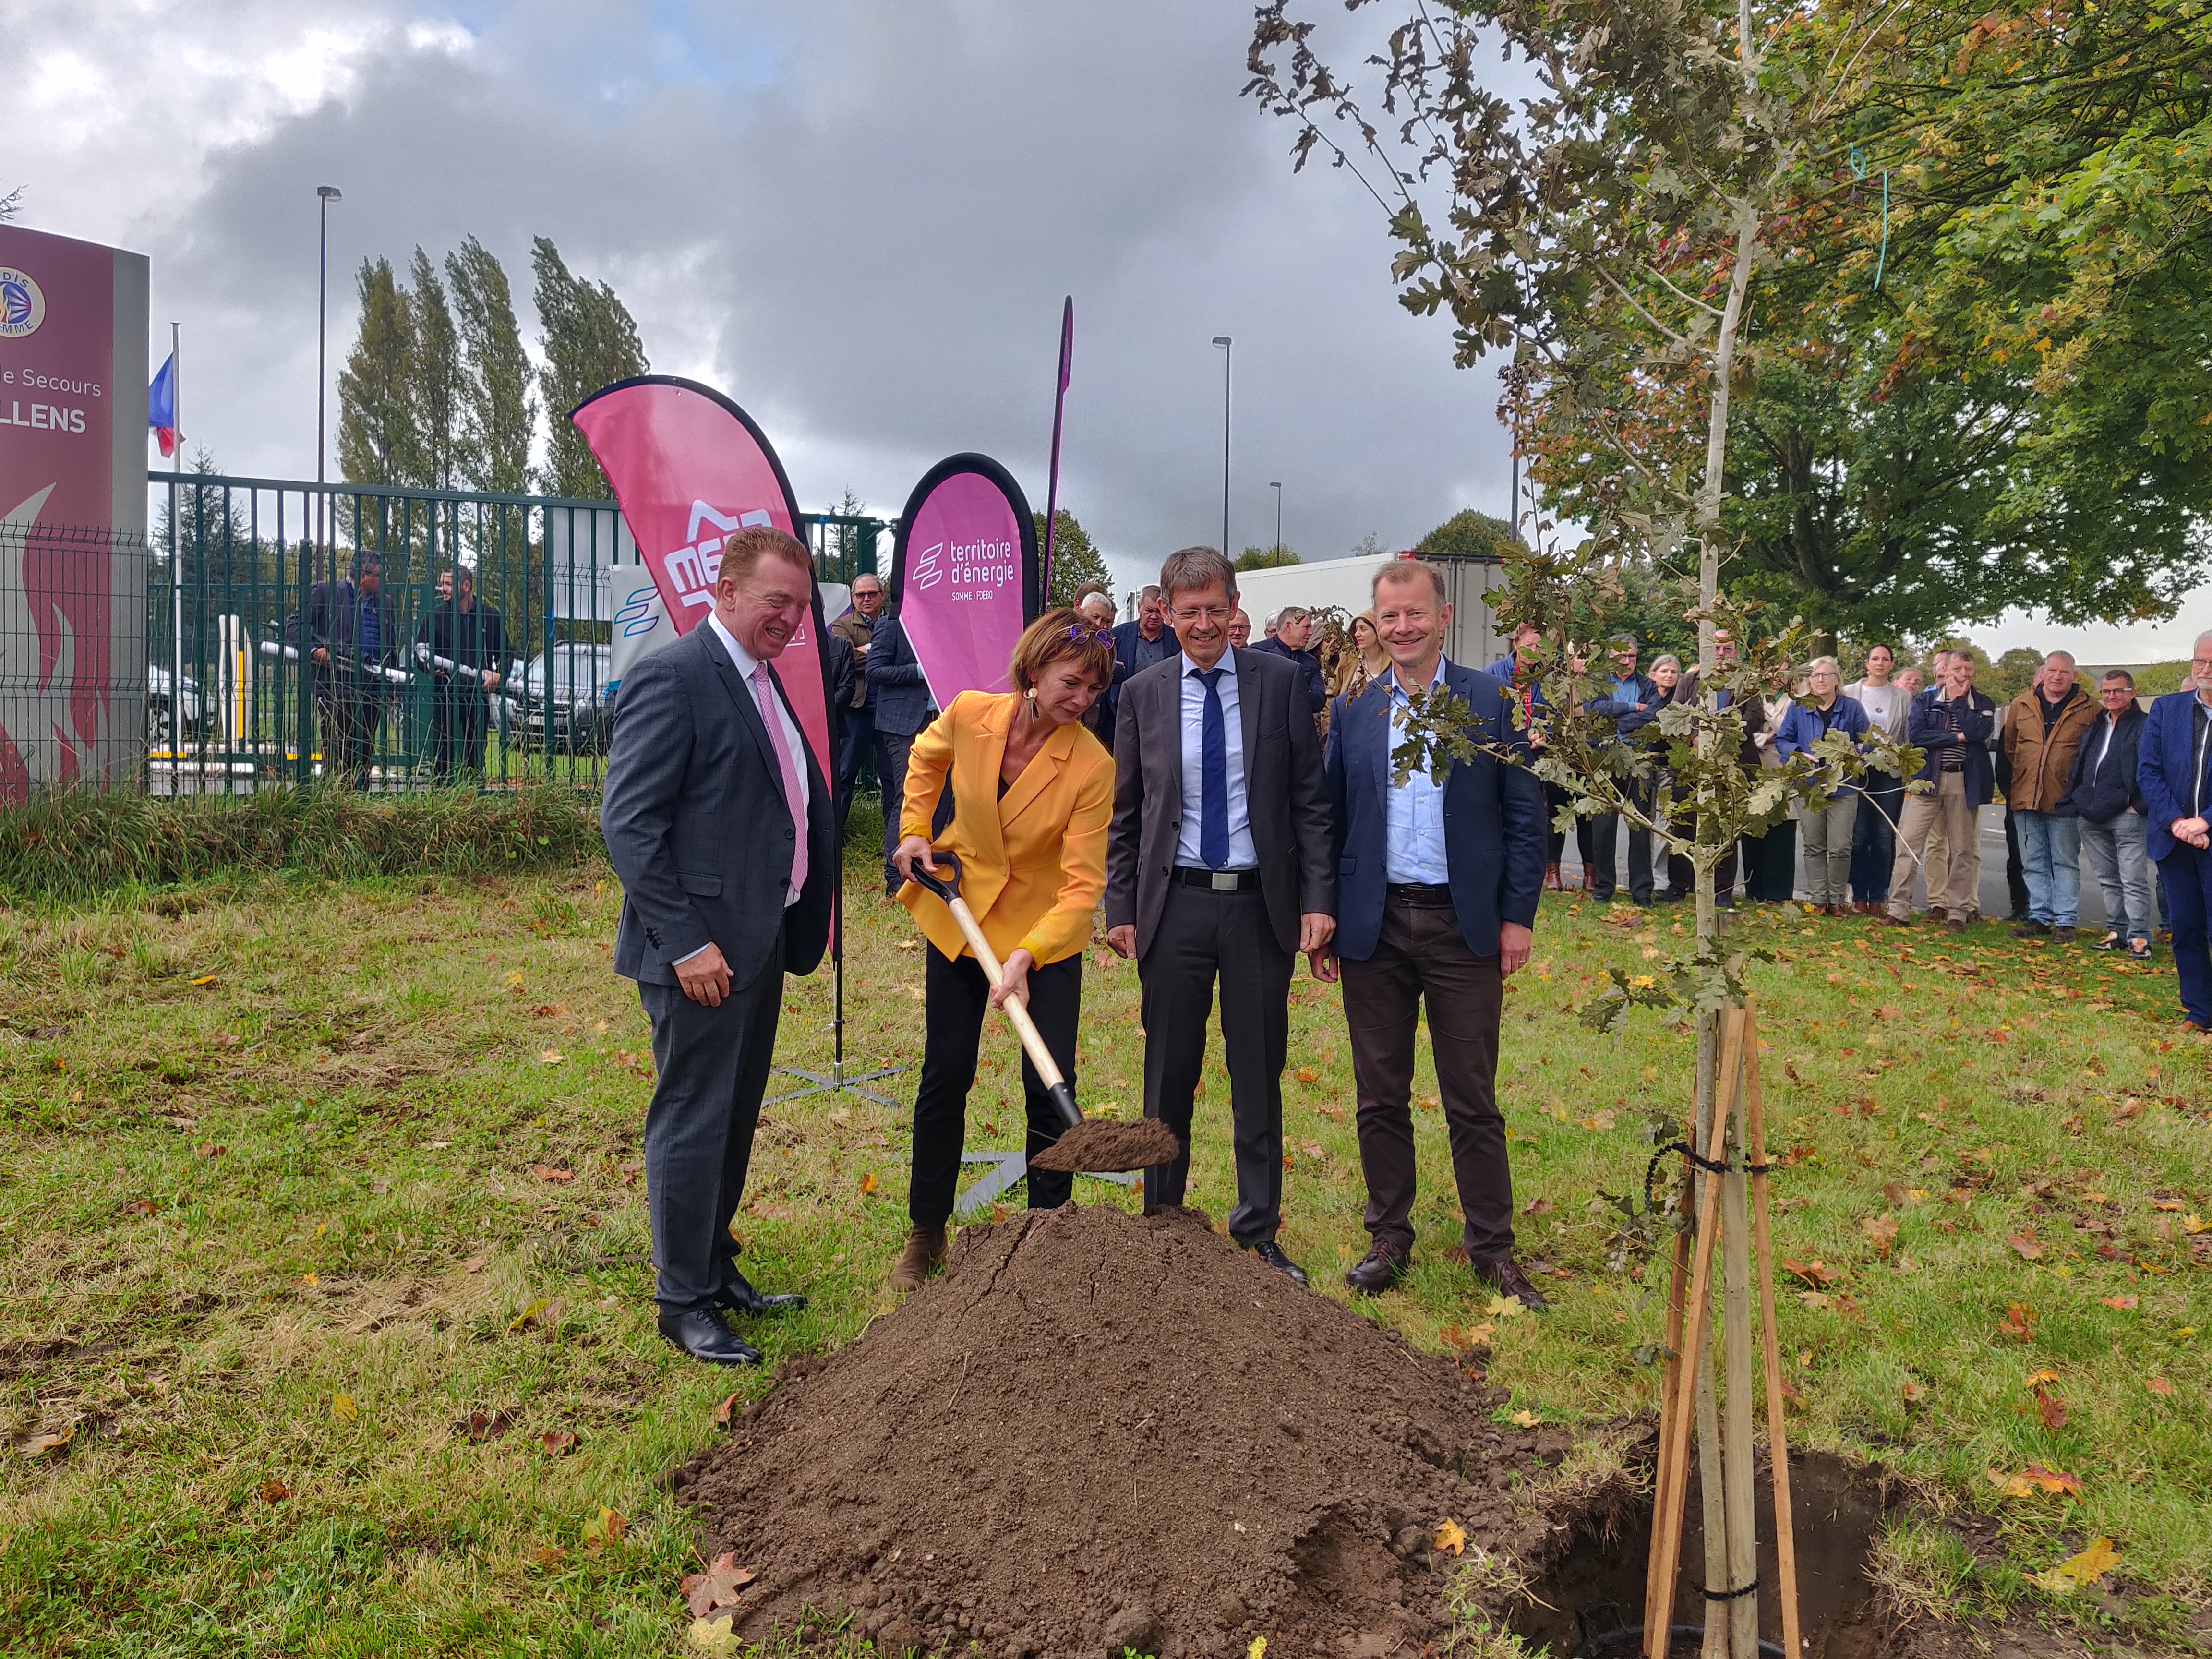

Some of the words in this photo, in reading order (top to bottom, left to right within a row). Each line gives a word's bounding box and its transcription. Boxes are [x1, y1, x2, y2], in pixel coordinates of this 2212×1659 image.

[0, 272, 29, 288] DIS
[0, 320, 33, 334] MME
[22, 368, 101, 397] Secours
[950, 538, 1010, 562] territoire
[951, 560, 1013, 587] d'énergie
[952, 591, 972, 601] SOMME
[976, 590, 993, 600] FDE80
